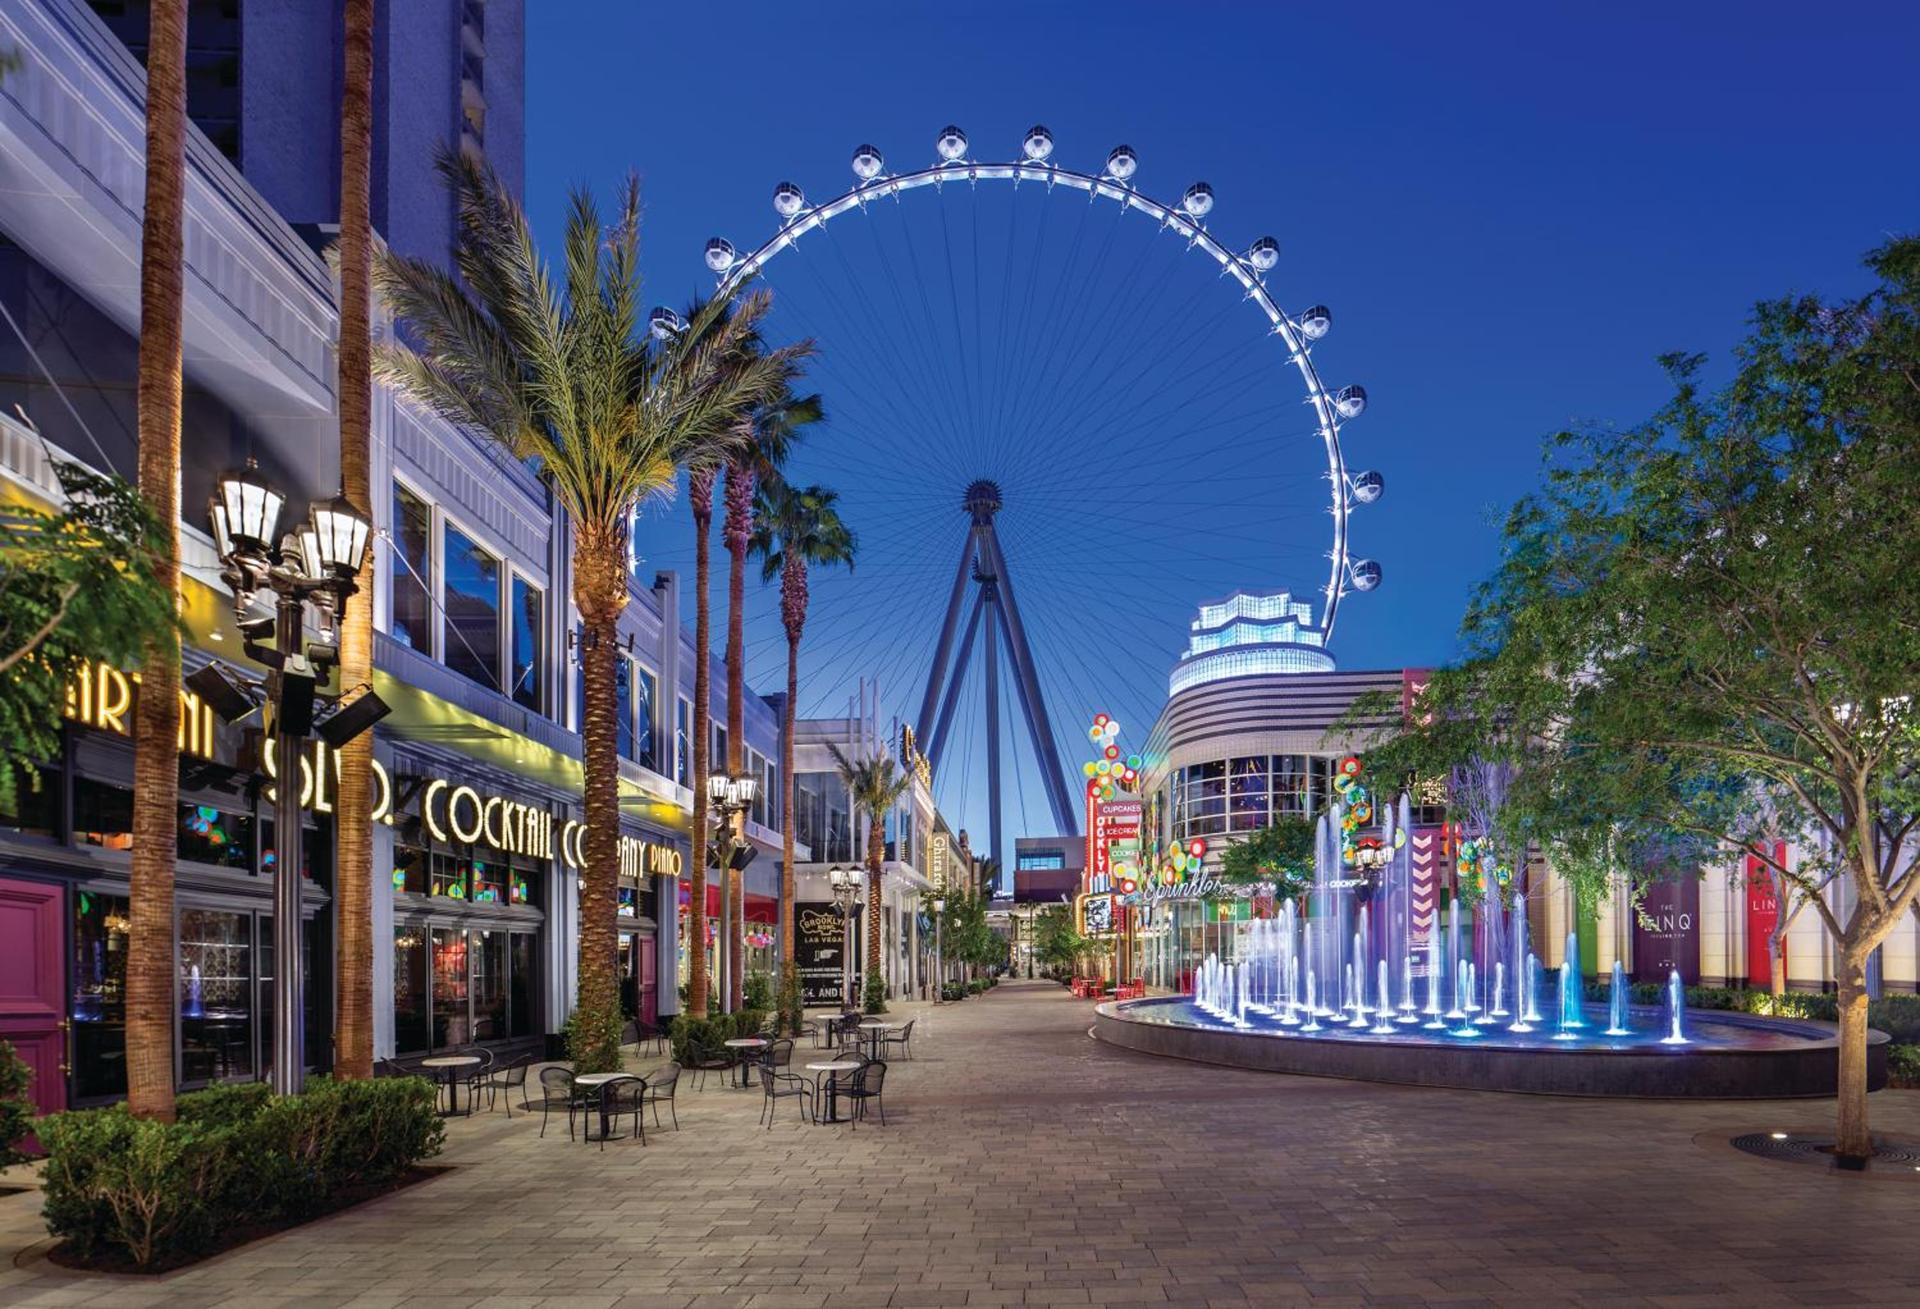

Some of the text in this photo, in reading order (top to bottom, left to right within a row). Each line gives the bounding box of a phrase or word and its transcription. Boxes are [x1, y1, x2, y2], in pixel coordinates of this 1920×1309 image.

[425, 780, 553, 859] COCKTAIL
[1103, 804, 1141, 813] CUPCAKES
[651, 844, 682, 877] PIANO
[1143, 869, 1223, 907] Sprinkles
[1752, 899, 1777, 911] LIN
[819, 988, 838, 997] AND
